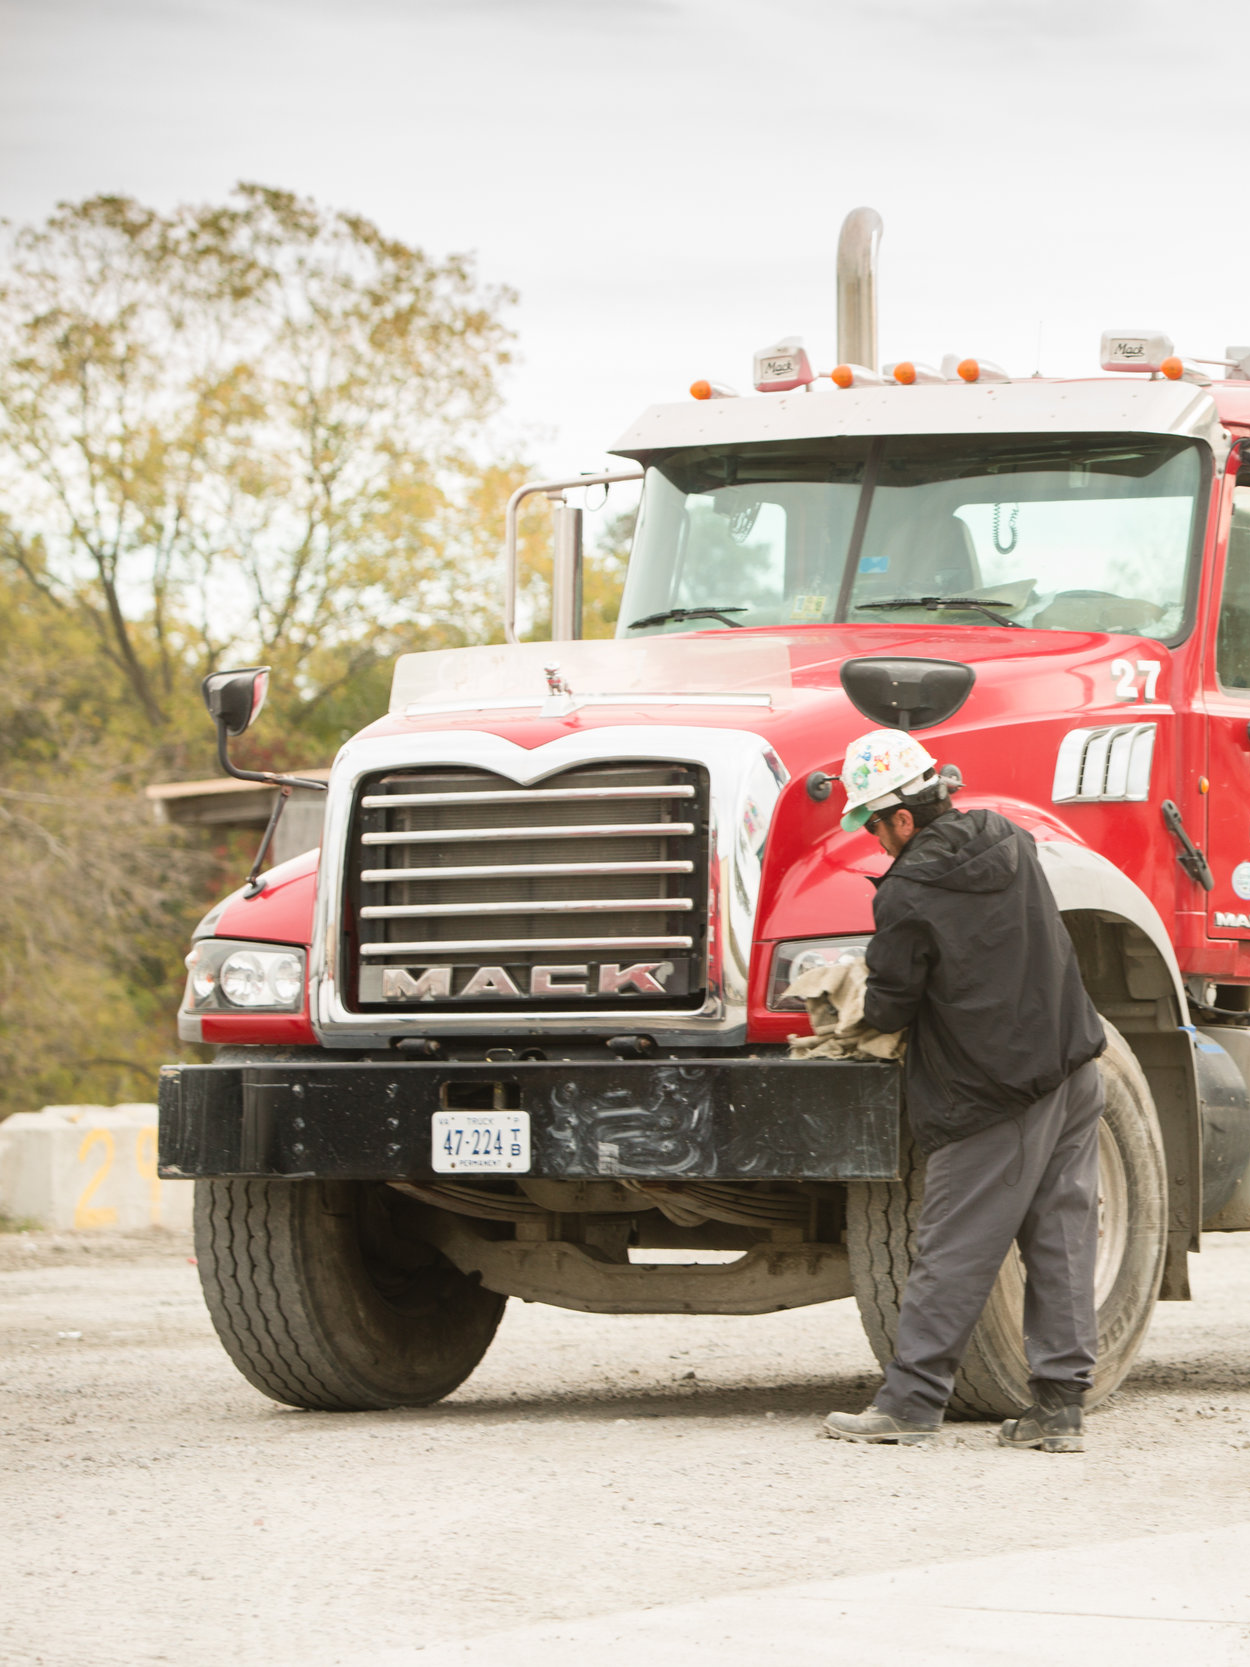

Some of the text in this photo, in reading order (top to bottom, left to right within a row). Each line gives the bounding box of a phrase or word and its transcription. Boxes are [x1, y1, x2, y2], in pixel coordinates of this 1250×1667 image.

[1113, 343, 1145, 358] Mack
[764, 361, 793, 376] Mack
[1110, 658, 1161, 702] 27
[382, 962, 668, 998] MACK
[466, 1117, 495, 1125] TRUCK
[443, 1128, 503, 1156] 47-224
[458, 1159, 502, 1167] PERMANENT
